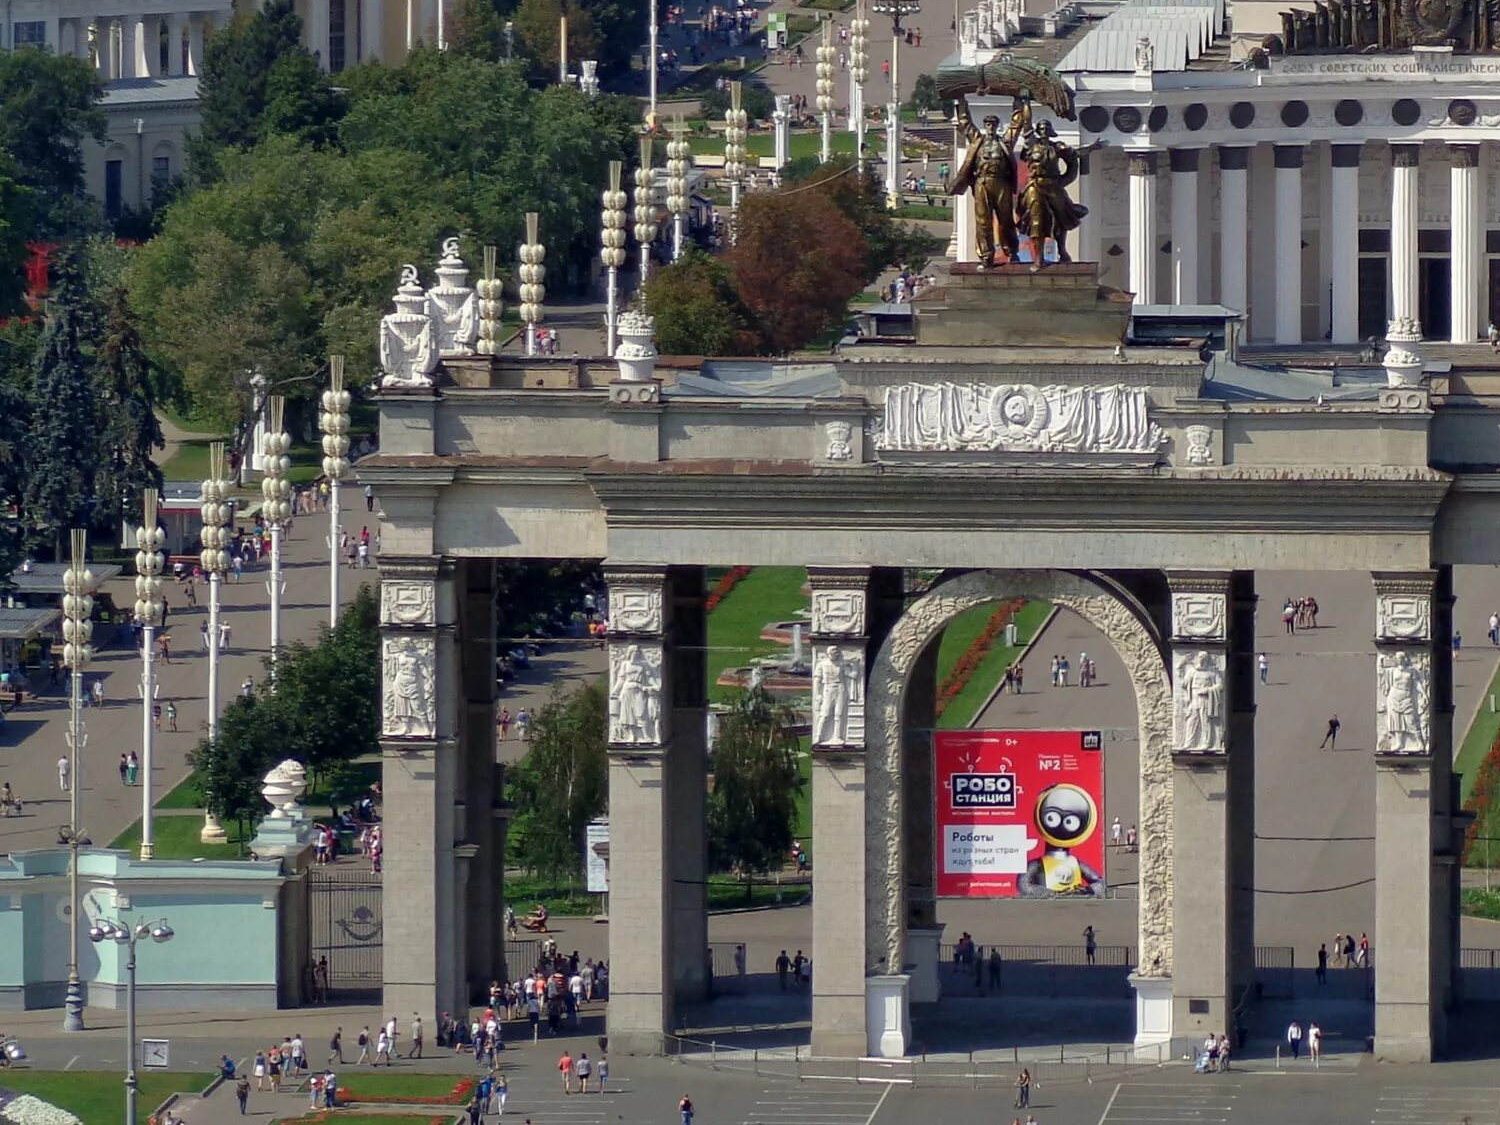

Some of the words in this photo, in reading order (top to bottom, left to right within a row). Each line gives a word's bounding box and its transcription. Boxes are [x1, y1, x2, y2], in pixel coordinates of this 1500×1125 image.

[1320, 63, 1387, 73] СОВЕТСКИХ
[1005, 738, 1017, 746] 0+
[1039, 759, 1061, 771] №2
[956, 777, 1011, 792] РОБО
[956, 793, 1011, 804] СТАНЦИЯ
[952, 831, 994, 842] Роботы
[995, 847, 1019, 855] стран
